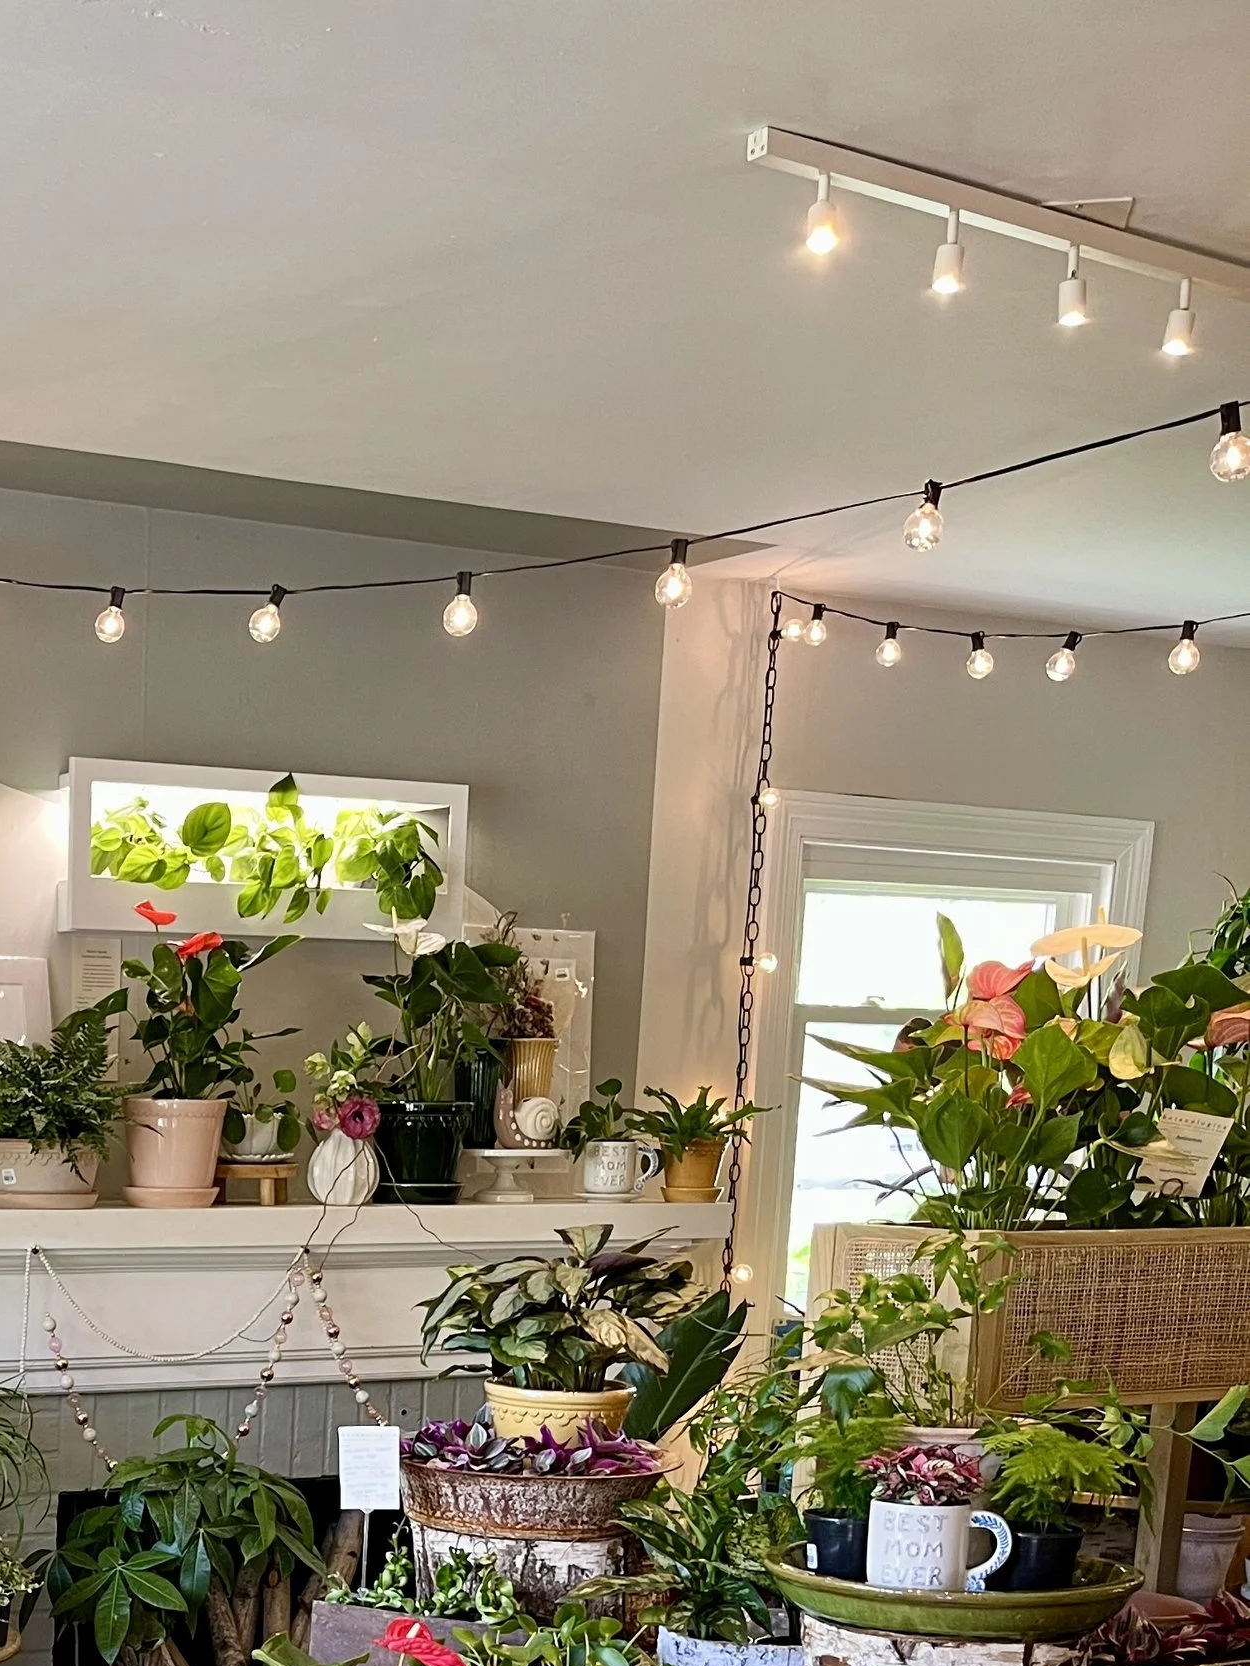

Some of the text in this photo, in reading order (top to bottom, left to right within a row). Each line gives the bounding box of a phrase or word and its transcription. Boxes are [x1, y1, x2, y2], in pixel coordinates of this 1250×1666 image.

[593, 1145, 628, 1158] BEST
[594, 1161, 626, 1171] MOM
[593, 1175, 626, 1187] EVER
[884, 1510, 949, 1534] BEST
[884, 1538, 944, 1558] MOM
[881, 1563, 943, 1586] EVER
